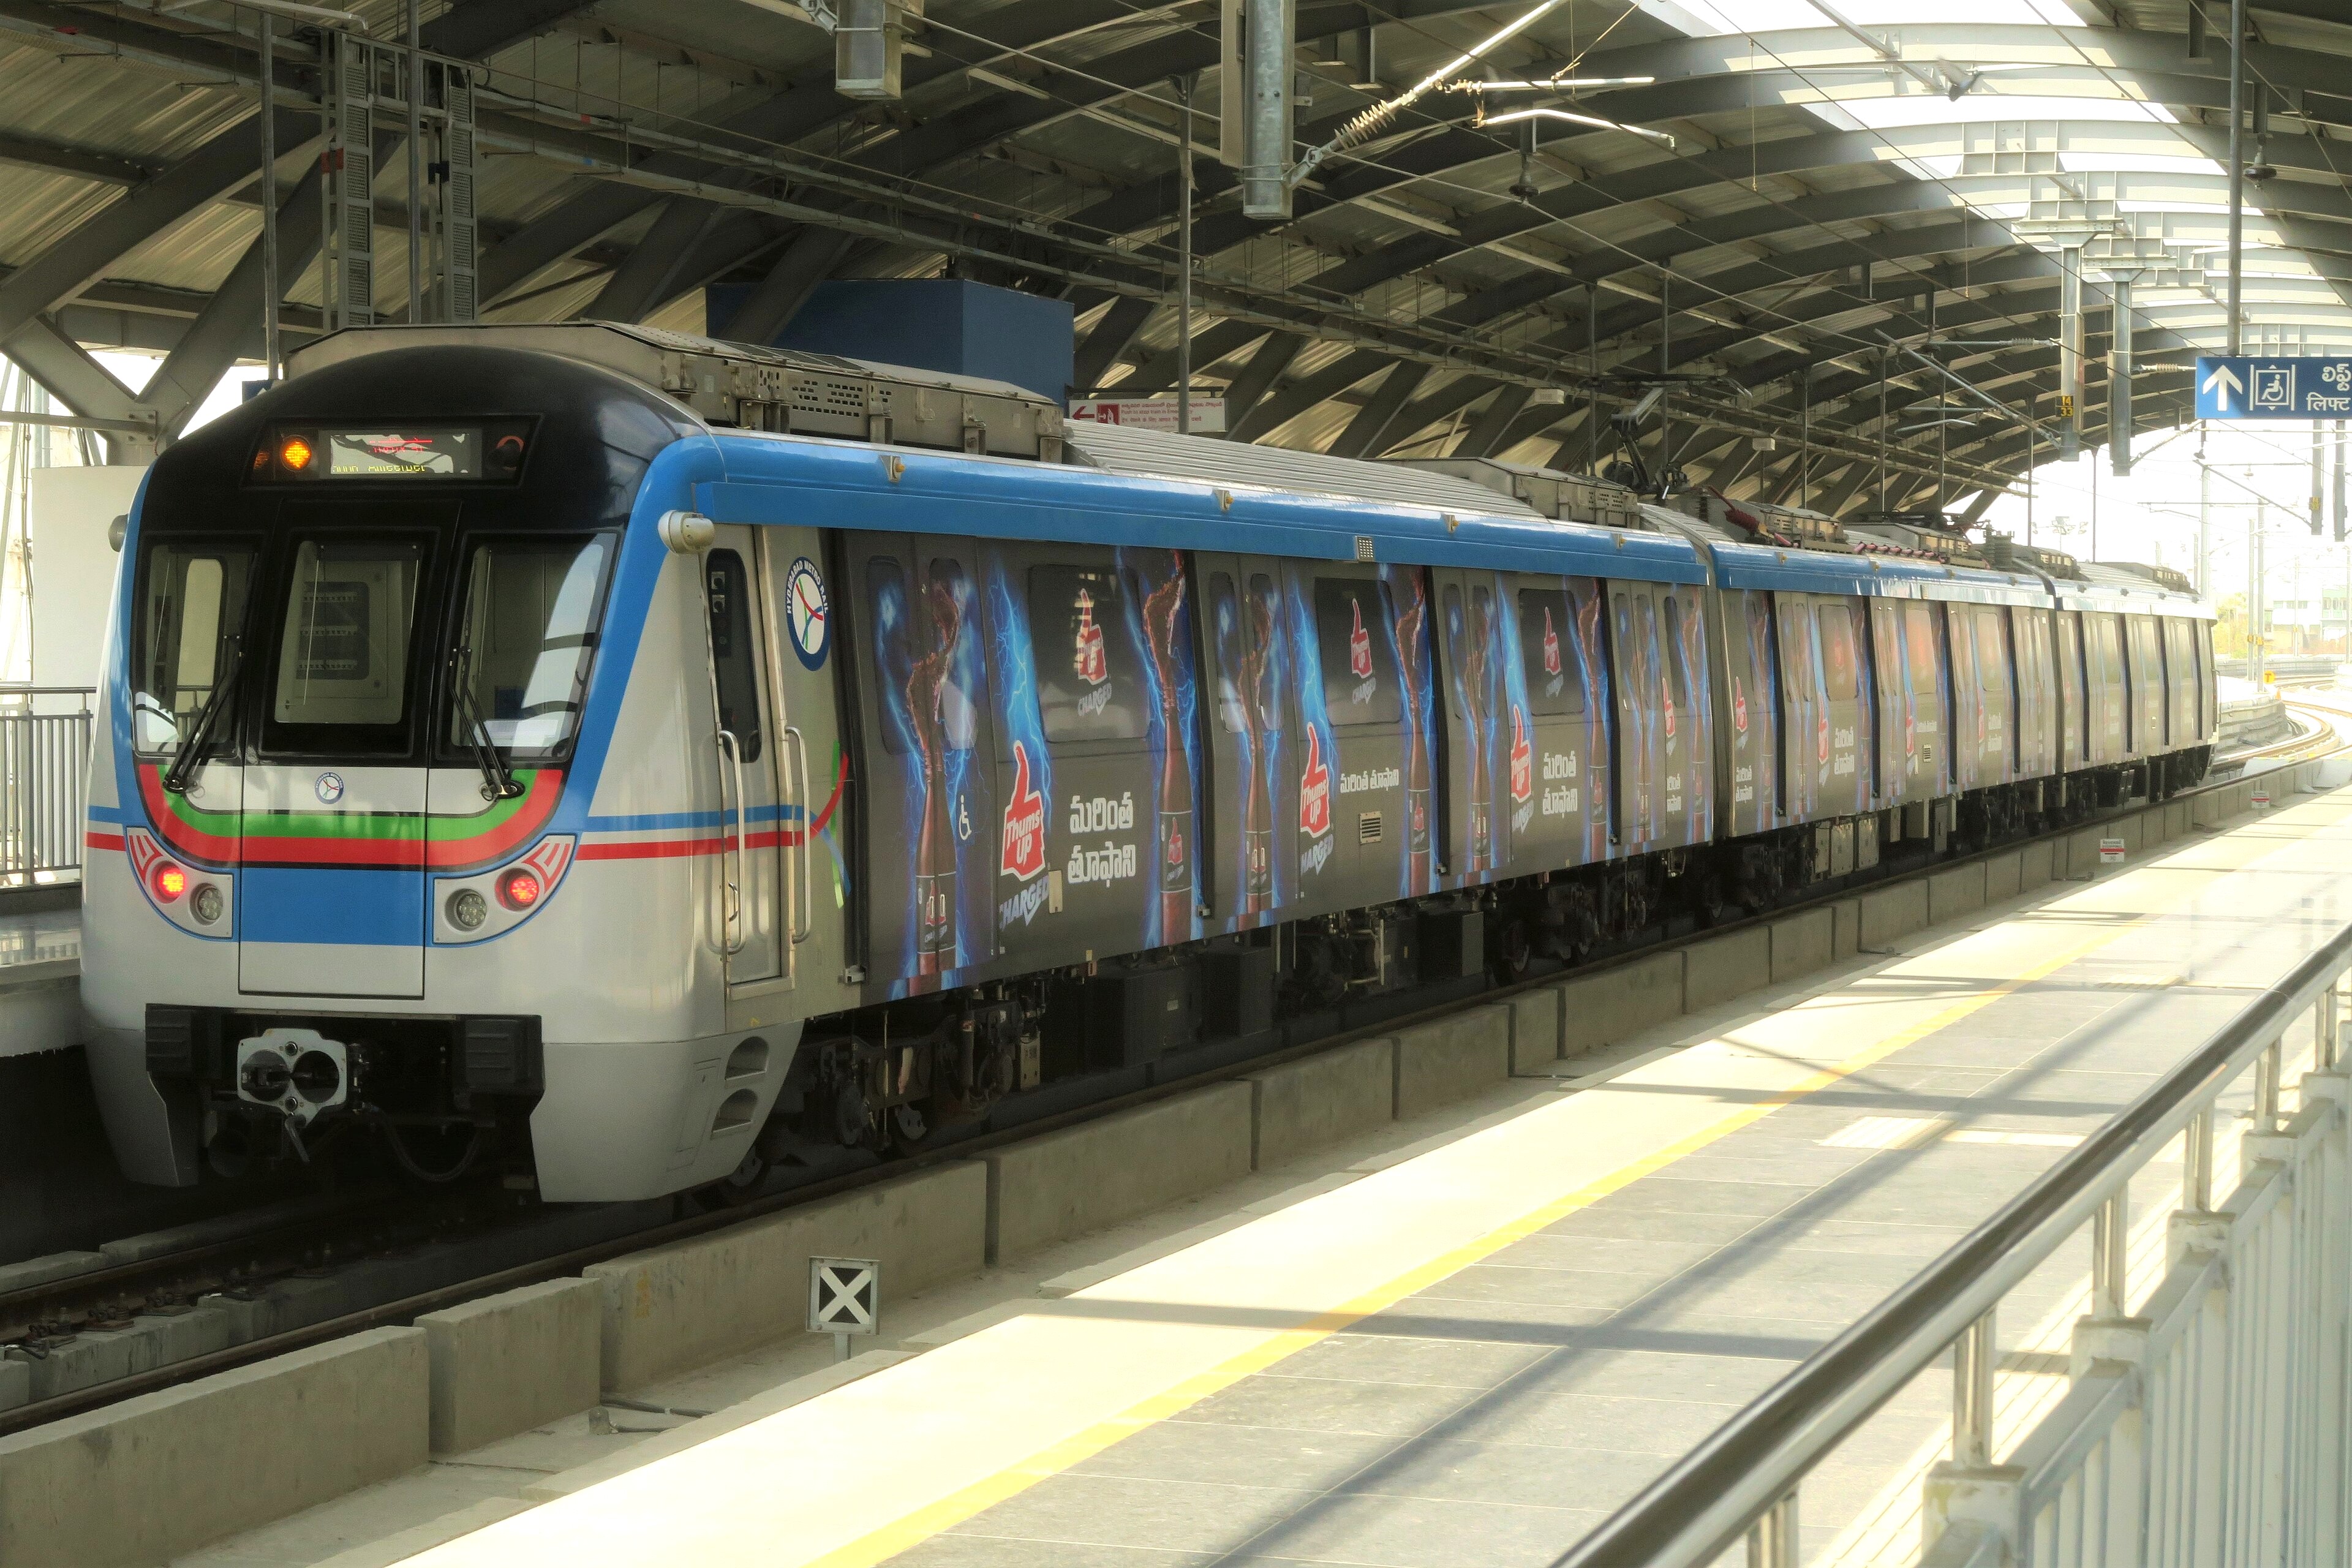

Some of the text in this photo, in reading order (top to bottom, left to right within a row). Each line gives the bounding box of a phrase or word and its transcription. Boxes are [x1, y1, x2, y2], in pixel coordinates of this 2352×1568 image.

[2306, 392, 2351, 412] लिफ्ट
[786, 560, 803, 614] HYDERABAD
[804, 560, 821, 586] METRO
[1005, 809, 1041, 851] Thums
[1070, 791, 1133, 834] మరింత
[1016, 833, 1033, 867] UP
[1300, 834, 1333, 876] HARGED
